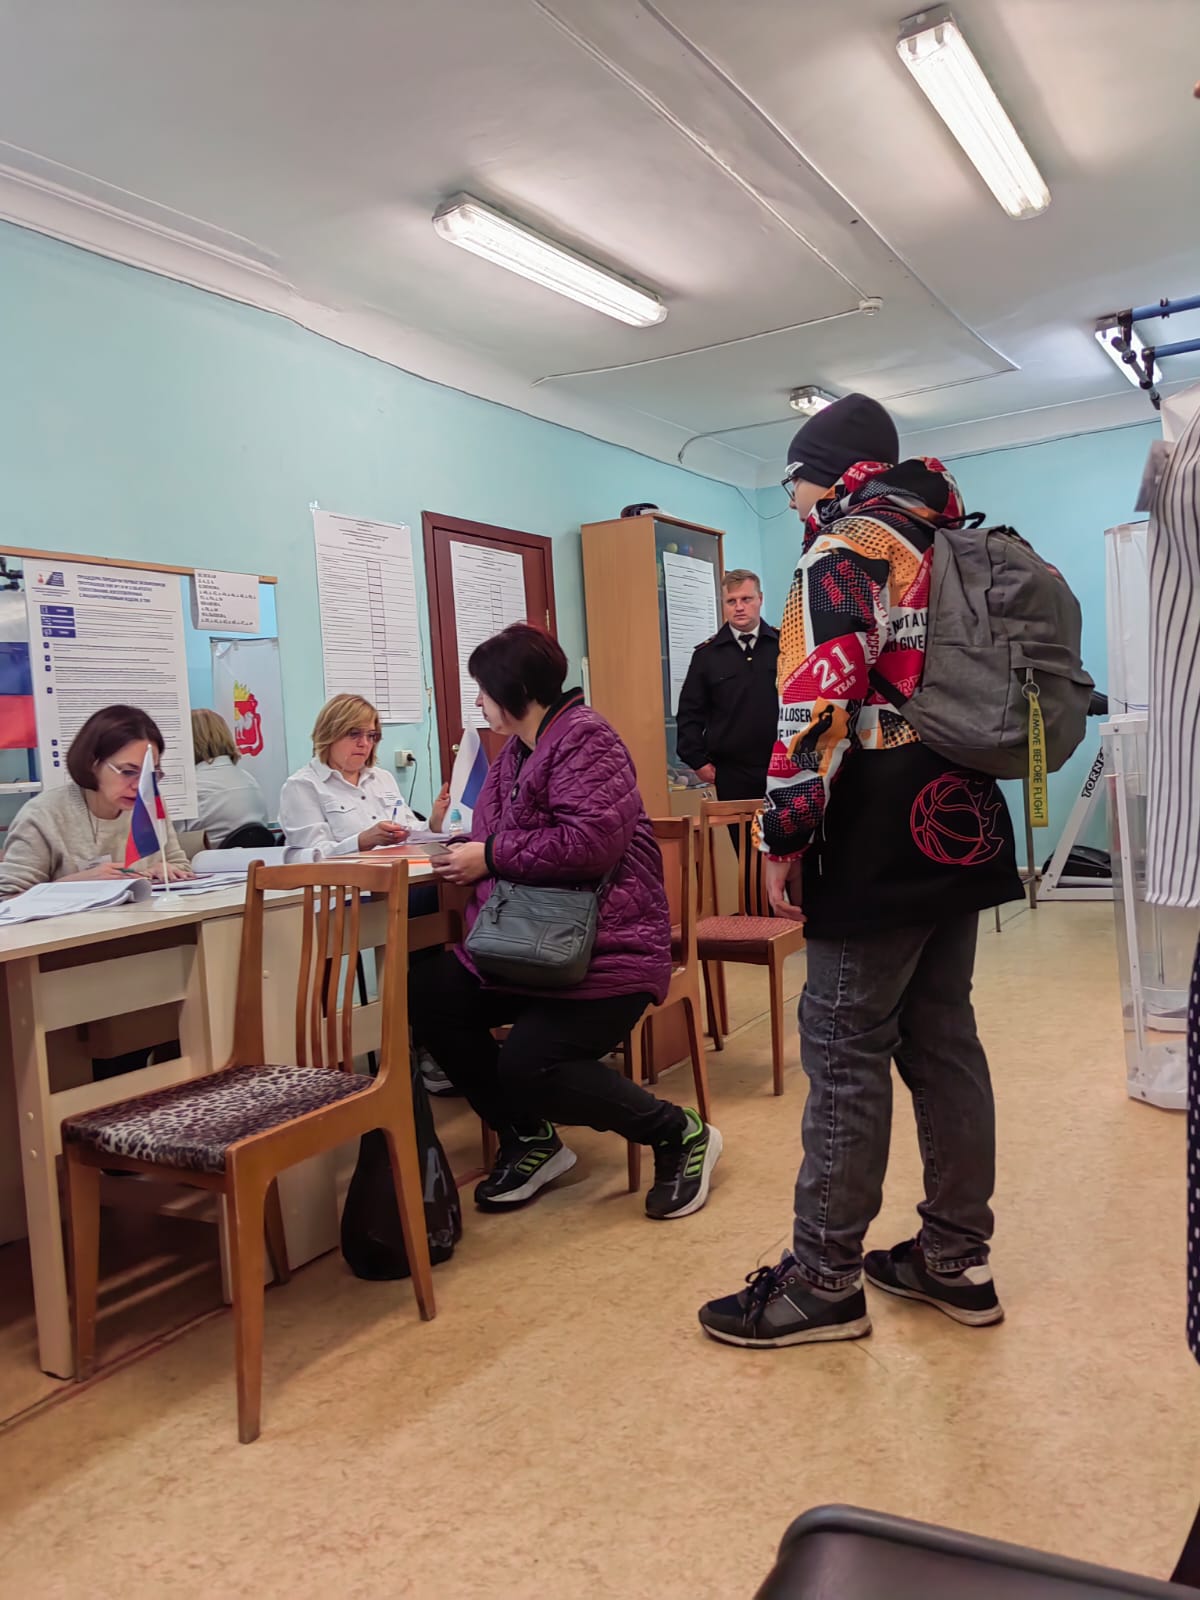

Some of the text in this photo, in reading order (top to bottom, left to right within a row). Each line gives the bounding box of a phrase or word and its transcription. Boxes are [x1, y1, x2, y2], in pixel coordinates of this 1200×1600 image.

[900, 635, 924, 651] GIVE
[813, 644, 857, 692] 21
[833, 676, 857, 695] YEAR
[785, 707, 812, 722] LOSER
[1032, 748, 1043, 784] BEFORE
[1032, 787, 1044, 820] FLIGHT
